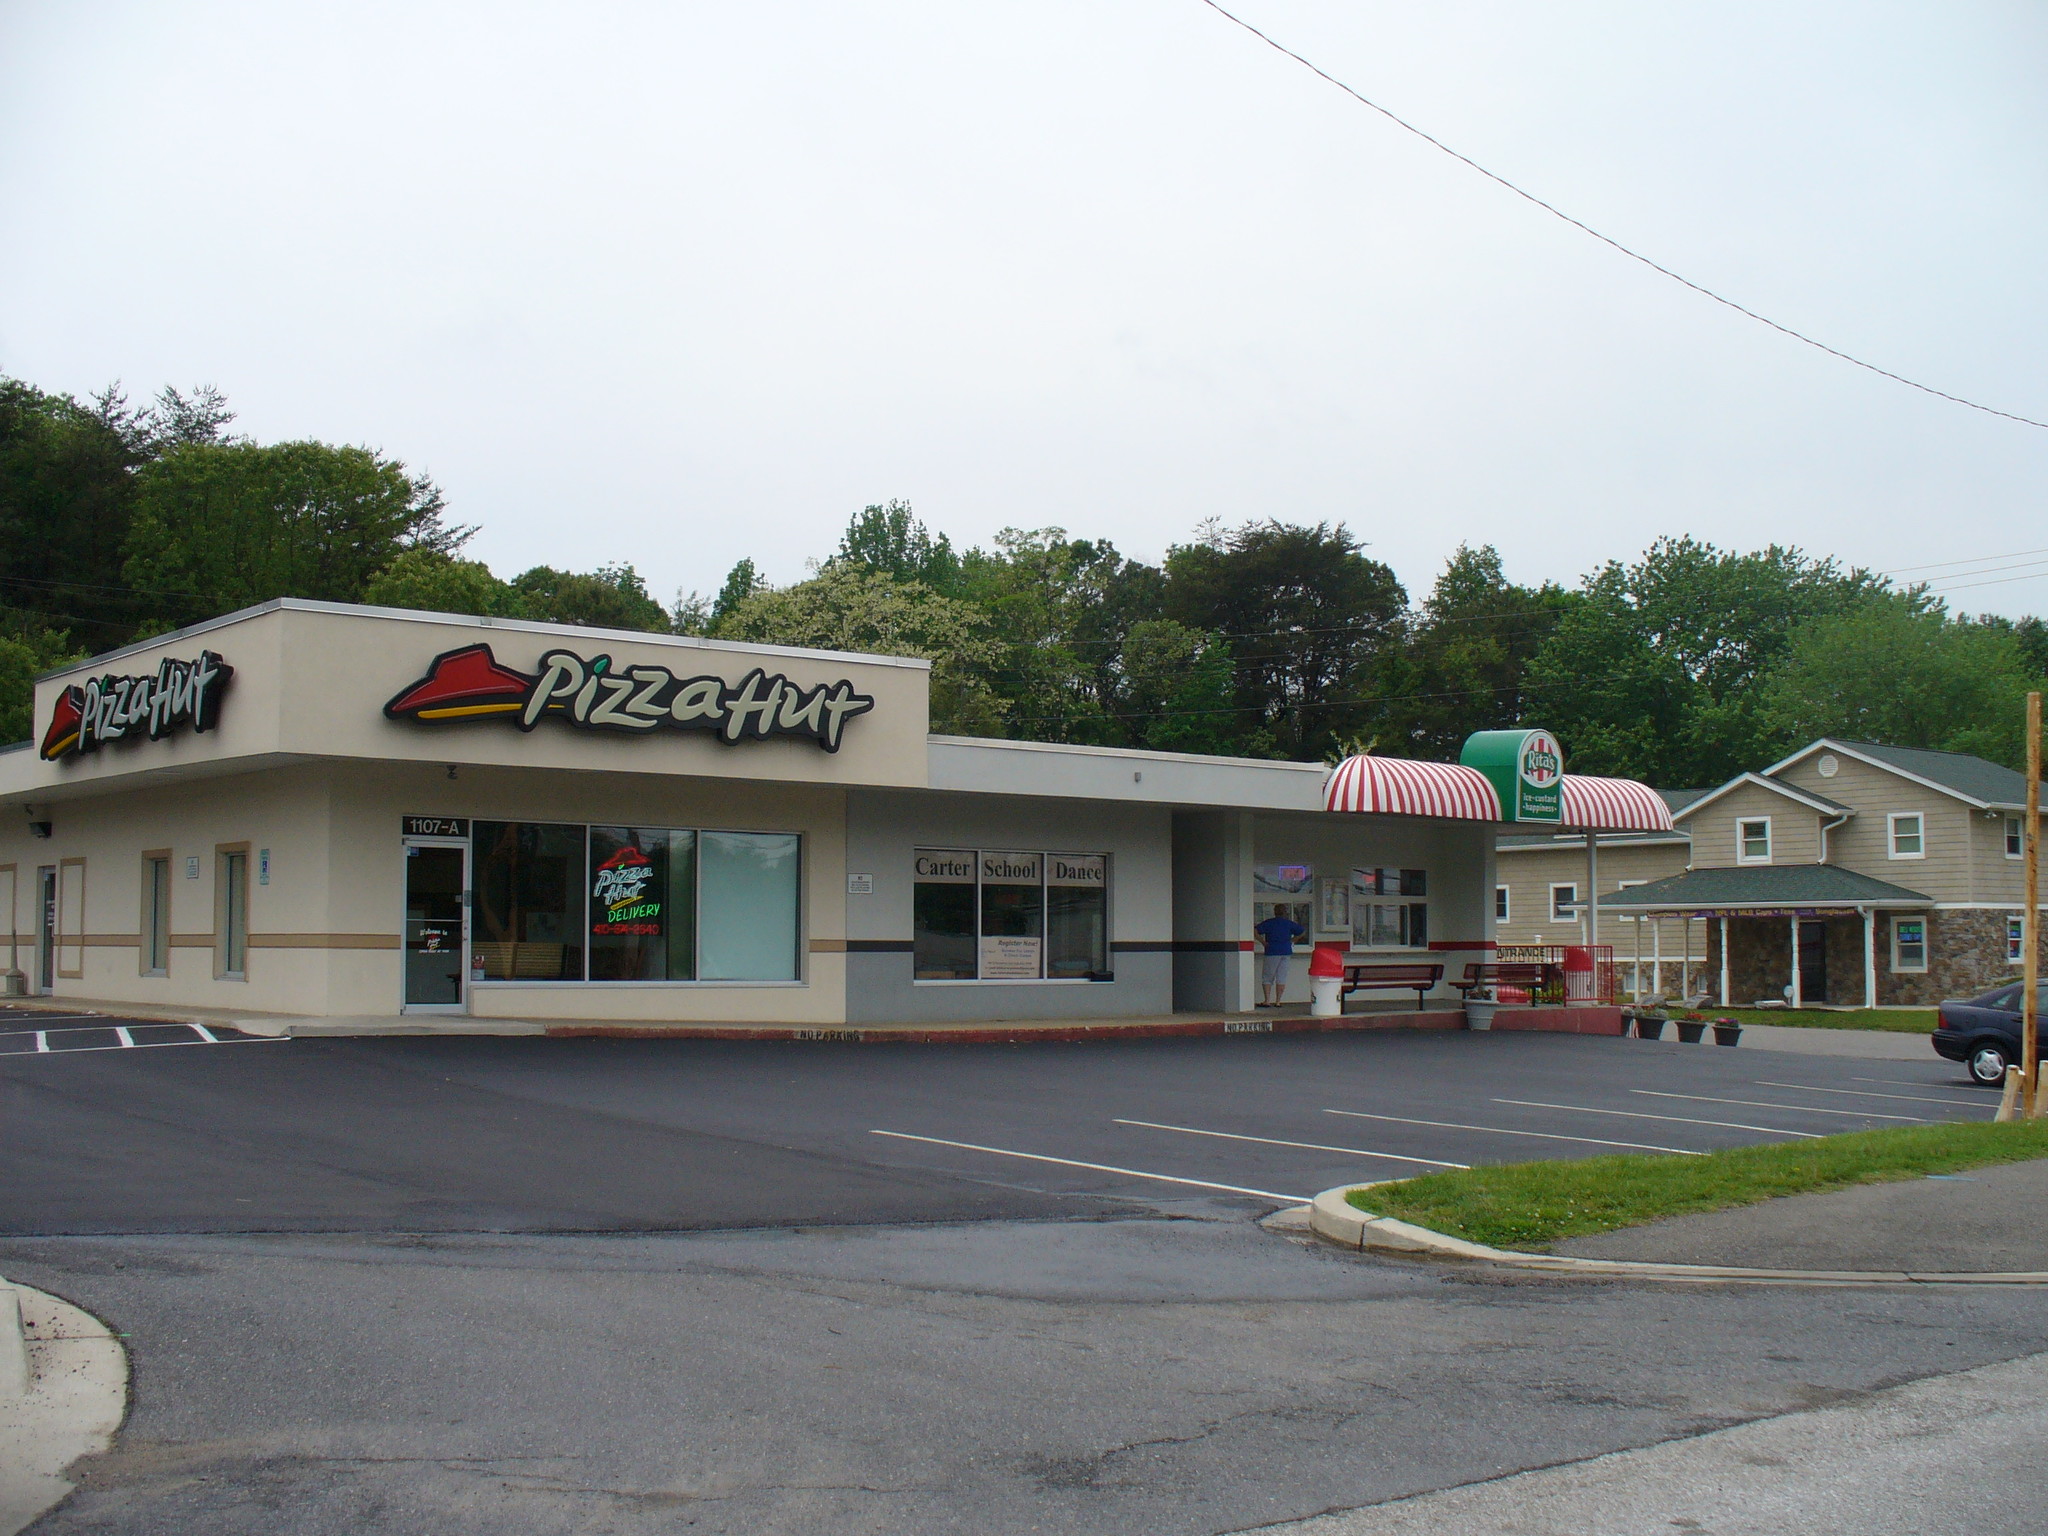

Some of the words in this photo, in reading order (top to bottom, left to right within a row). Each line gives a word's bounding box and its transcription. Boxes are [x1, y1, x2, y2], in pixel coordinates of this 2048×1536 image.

[78, 677, 150, 751] Pizza
[150, 656, 220, 736] Hut
[522, 653, 725, 729] Pizza
[725, 672, 871, 748] Hut
[1528, 750, 1555, 771] Rita's
[410, 818, 460, 834] 1107-A
[915, 857, 970, 877] Carter
[984, 859, 1036, 879] School
[1056, 861, 1102, 880] Dance
[593, 863, 654, 898] Pizza
[607, 903, 661, 923] DELIVERY
[1497, 947, 1546, 958] NTRANCE
[800, 1029, 814, 1041] NO
[816, 1029, 860, 1042] PARKING
[1227, 1022, 1237, 1033] NO
[1238, 1021, 1271, 1033] PARKING
